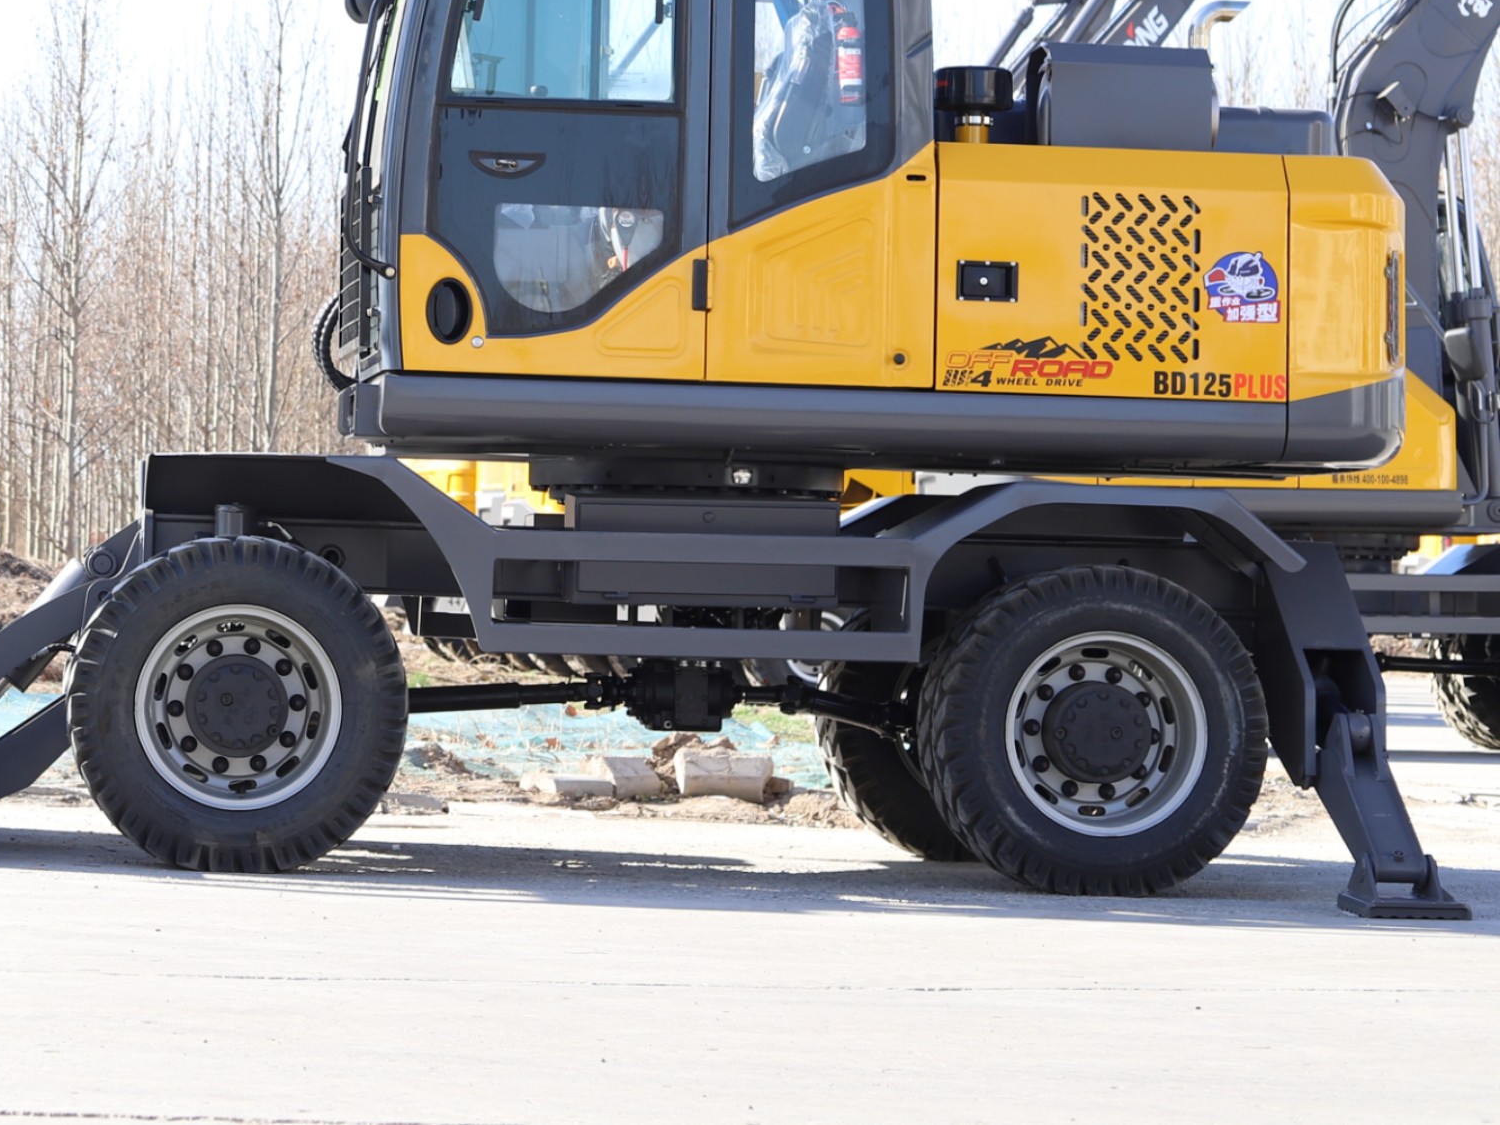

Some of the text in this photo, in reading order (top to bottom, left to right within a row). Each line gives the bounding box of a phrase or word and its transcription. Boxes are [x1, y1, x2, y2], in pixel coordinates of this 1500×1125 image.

[1225, 301, 1279, 323] 加强型
[945, 350, 1114, 380] OFF ROAD
[996, 377, 1039, 387] WHEEL
[1045, 378, 1084, 388] DRIVE
